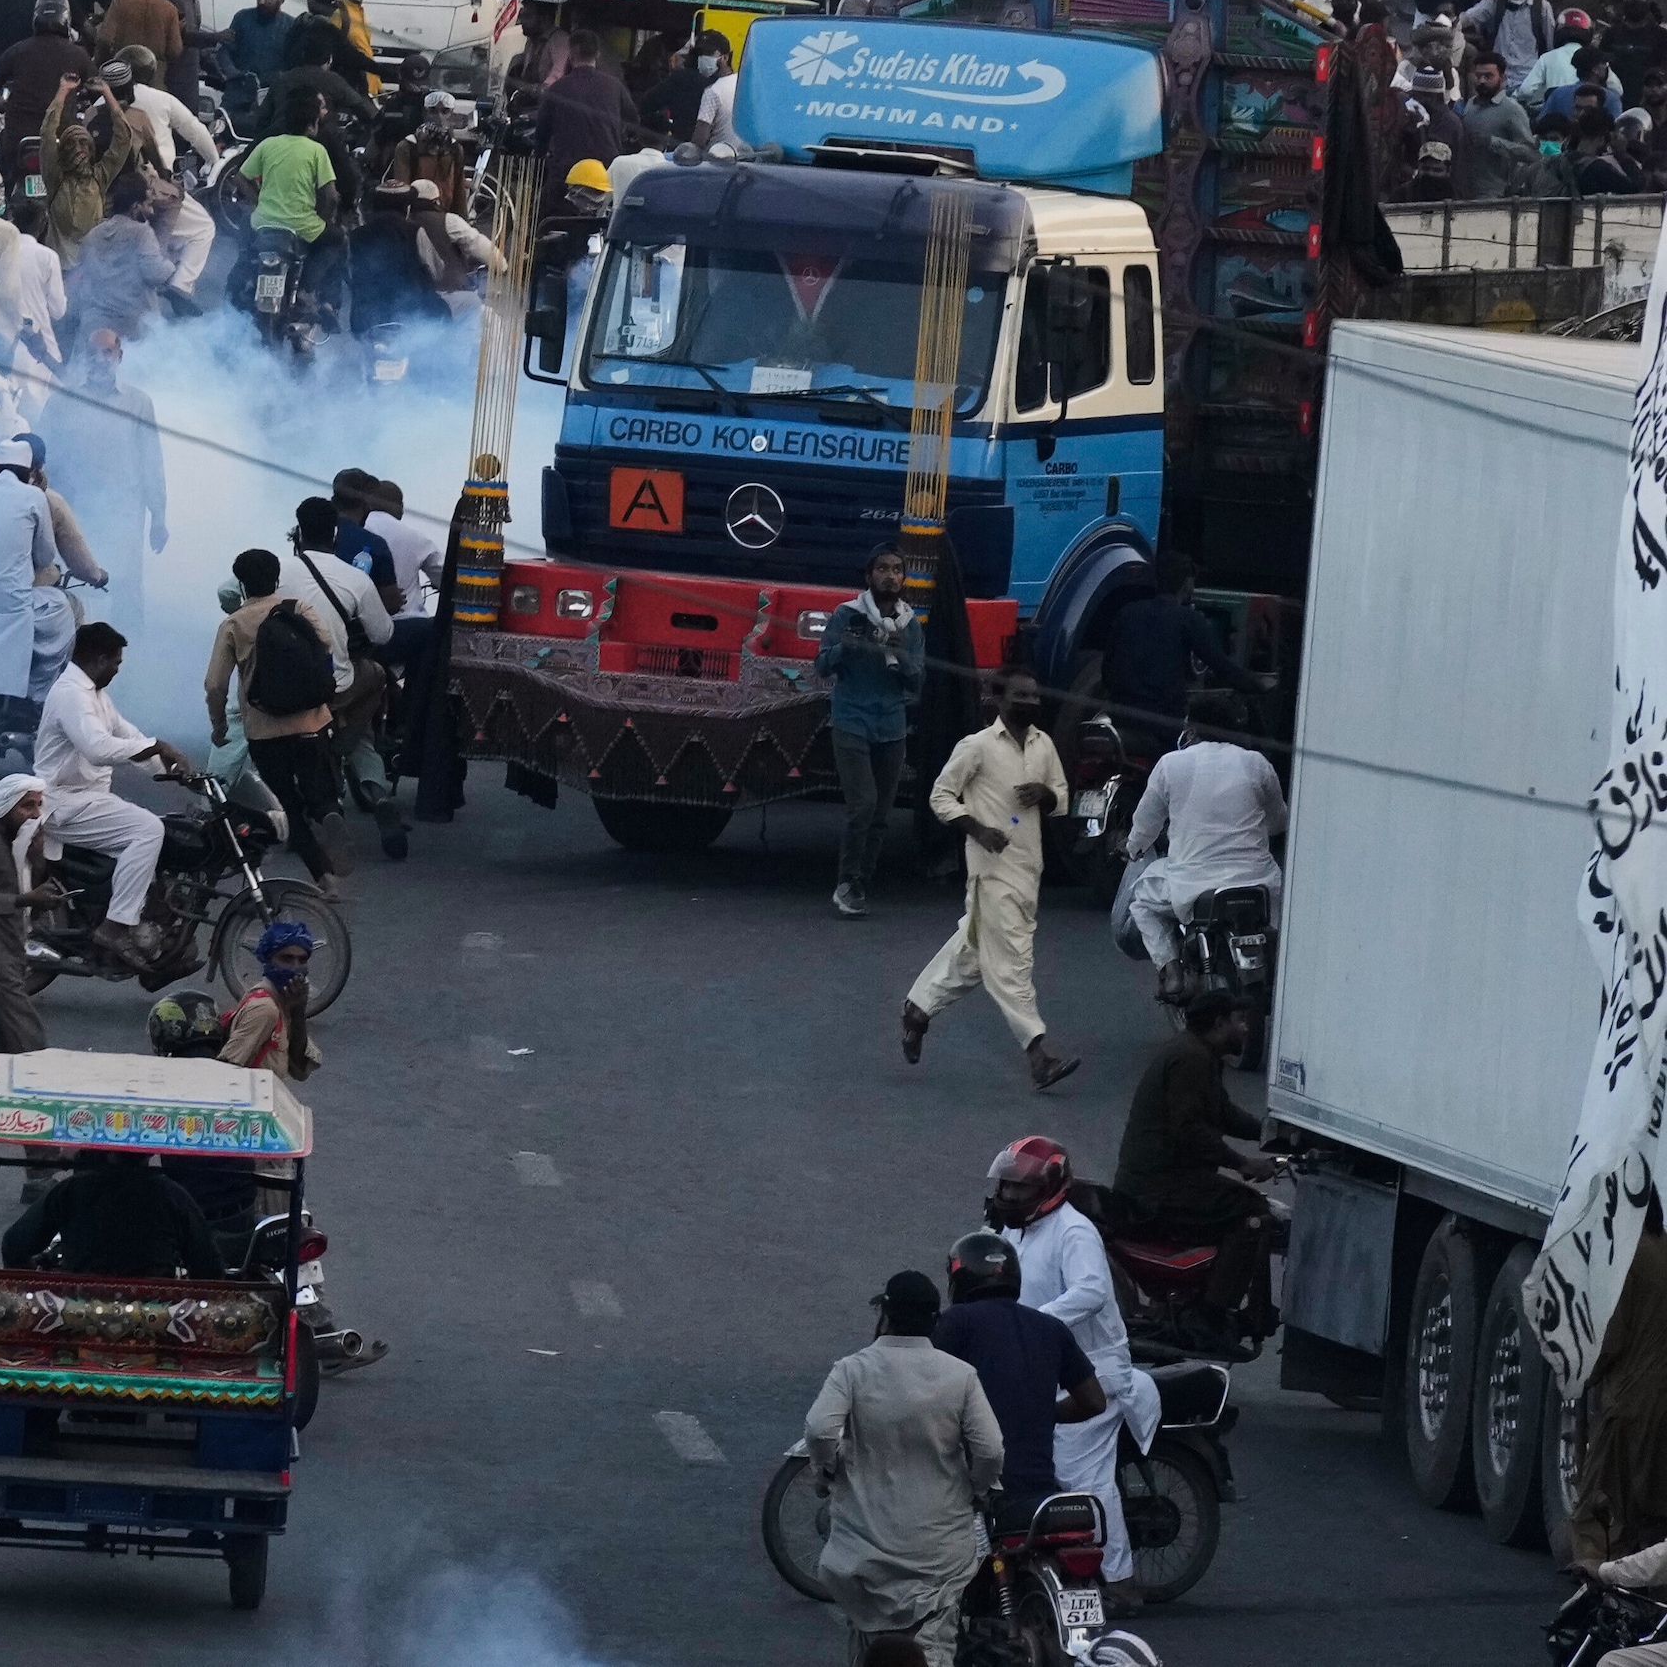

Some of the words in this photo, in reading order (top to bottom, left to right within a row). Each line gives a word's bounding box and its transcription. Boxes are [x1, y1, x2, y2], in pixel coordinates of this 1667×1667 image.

[847, 47, 939, 82] Sudais
[938, 53, 1011, 88] Khan
[805, 101, 1006, 133] MOHMAND
[609, 416, 702, 447] CARBO
[1045, 461, 1078, 474] CARBO
[621, 478, 670, 525] A
[69, 1109, 262, 1150] SUZUKI
[1048, 1504, 1089, 1513] HONDA
[1070, 1598, 1096, 1611] LEW
